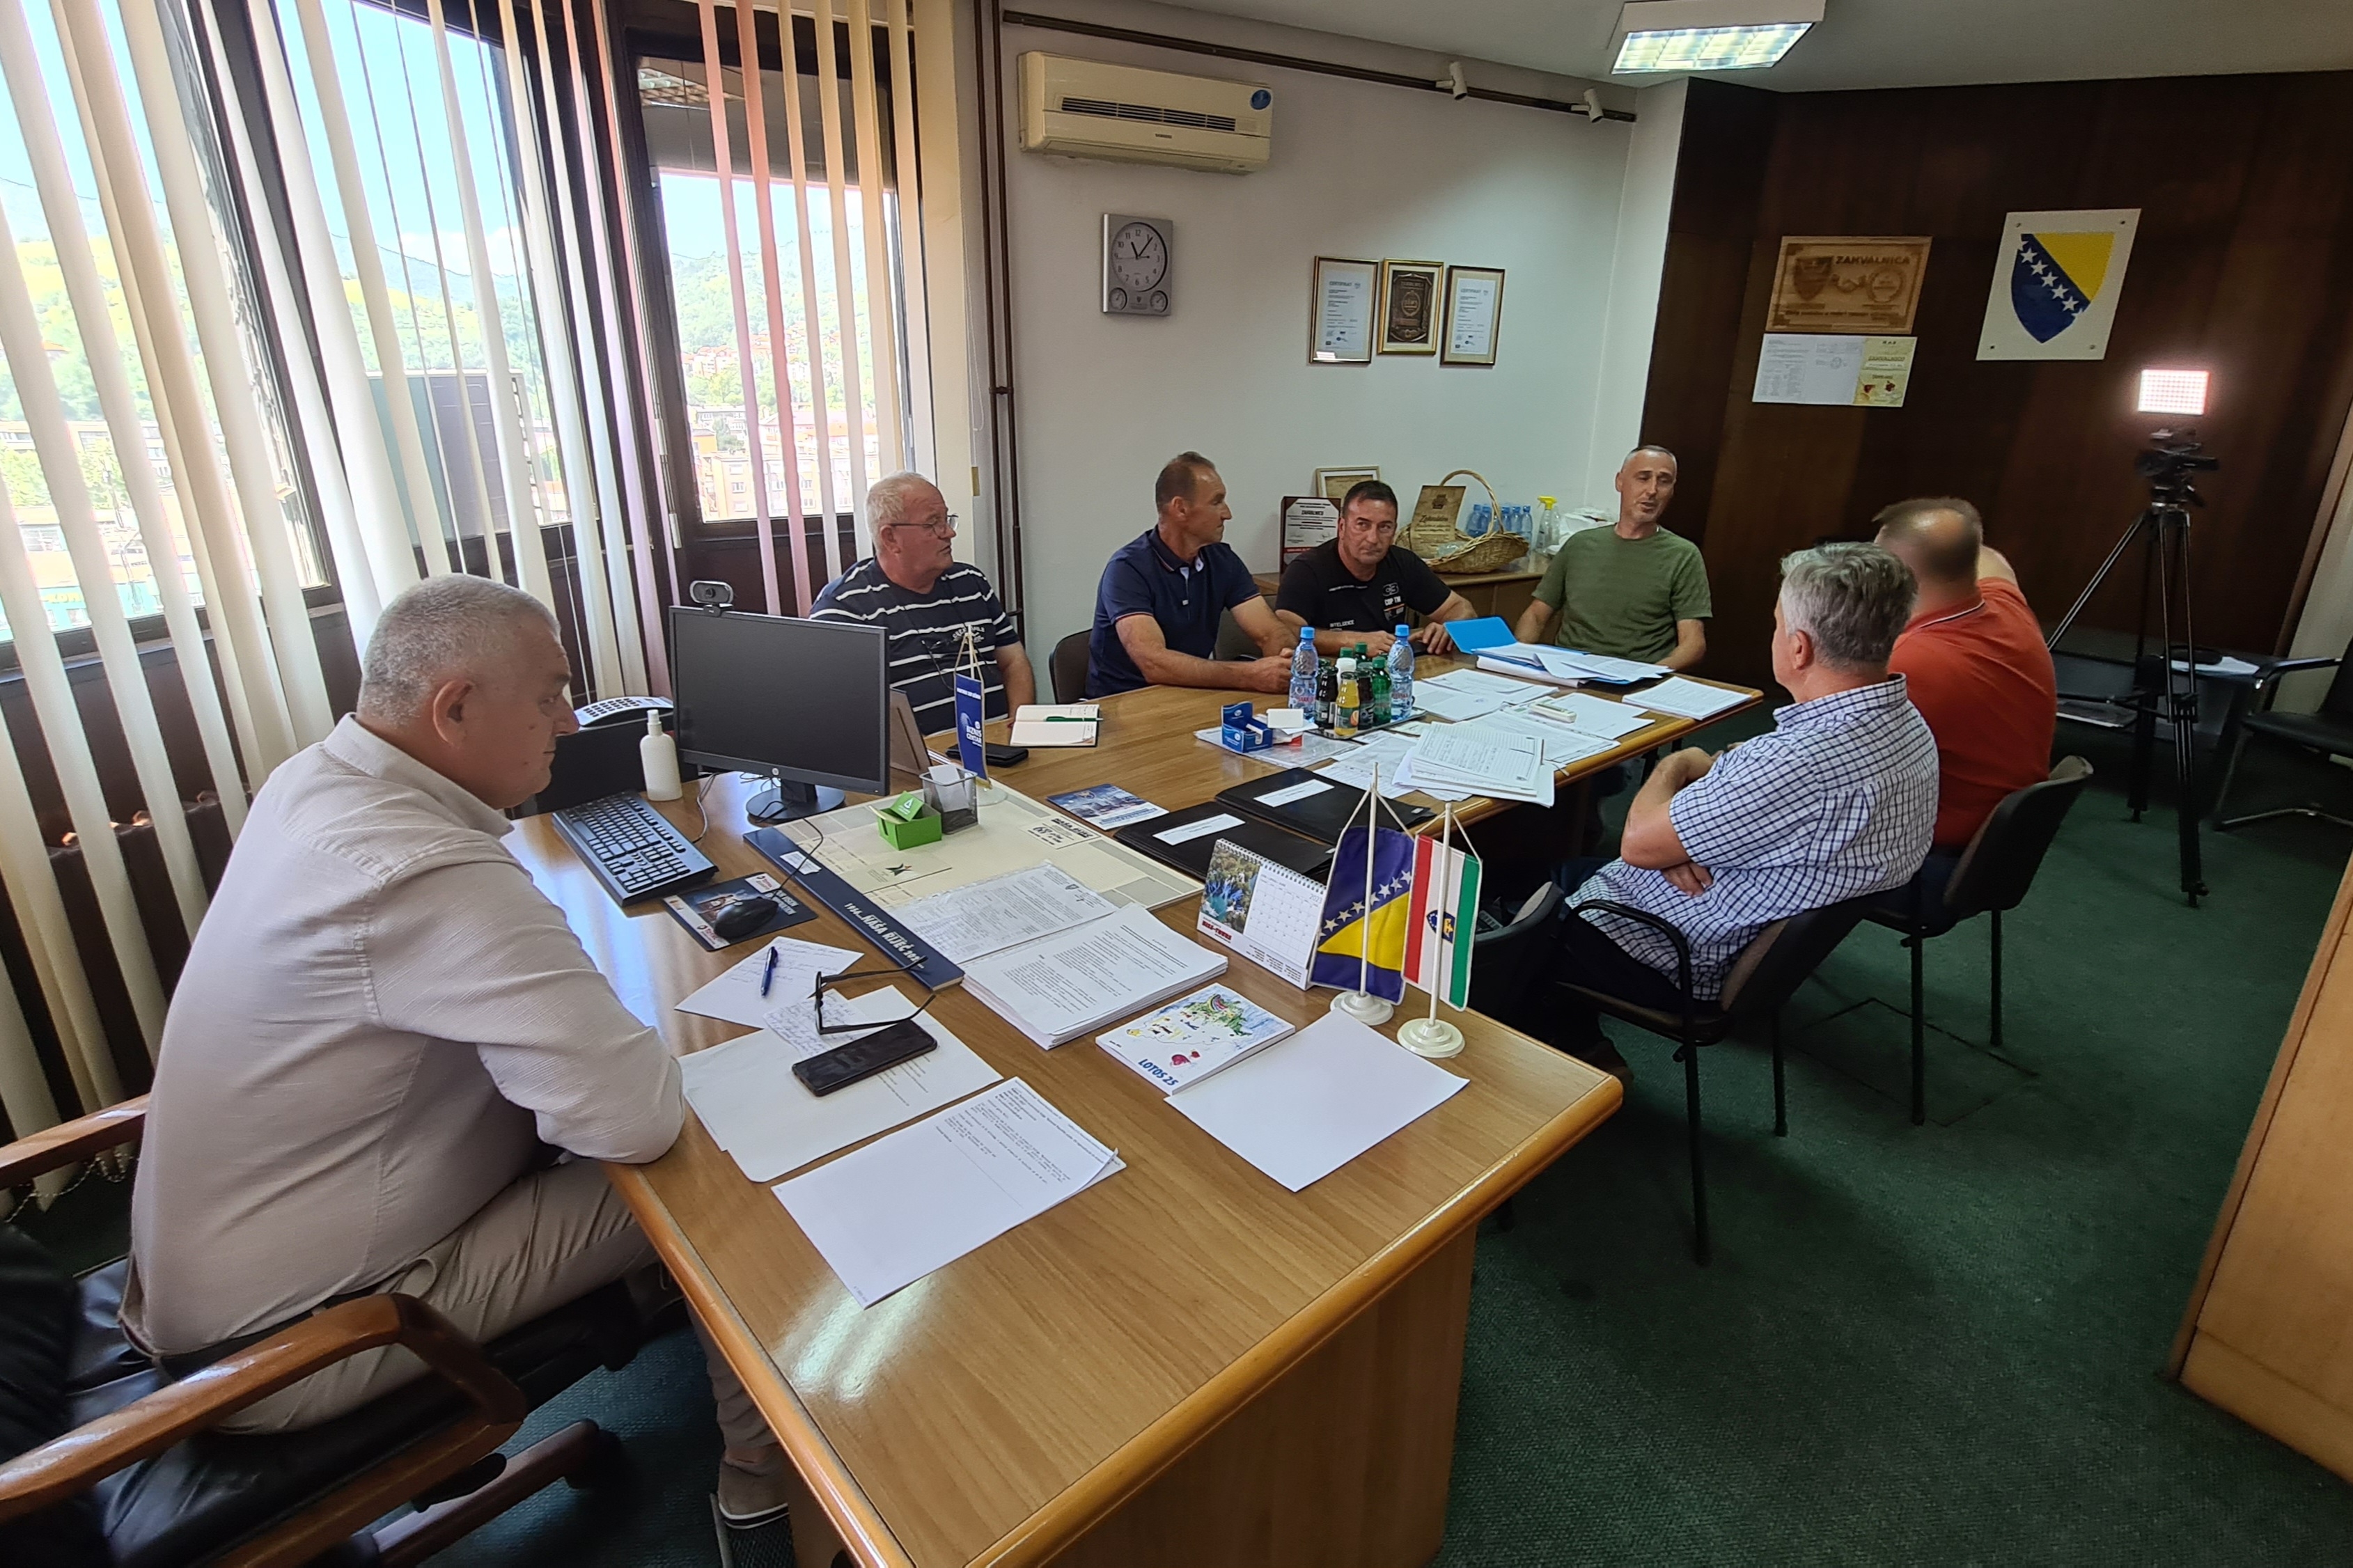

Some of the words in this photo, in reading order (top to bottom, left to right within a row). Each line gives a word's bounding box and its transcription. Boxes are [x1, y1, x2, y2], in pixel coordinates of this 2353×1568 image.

[861, 914, 889, 934] NAŠA
[882, 932, 914, 952] RIJEČ
[1138, 1058, 1168, 1079] LOTOS
[1162, 1076, 1179, 1086] 25
